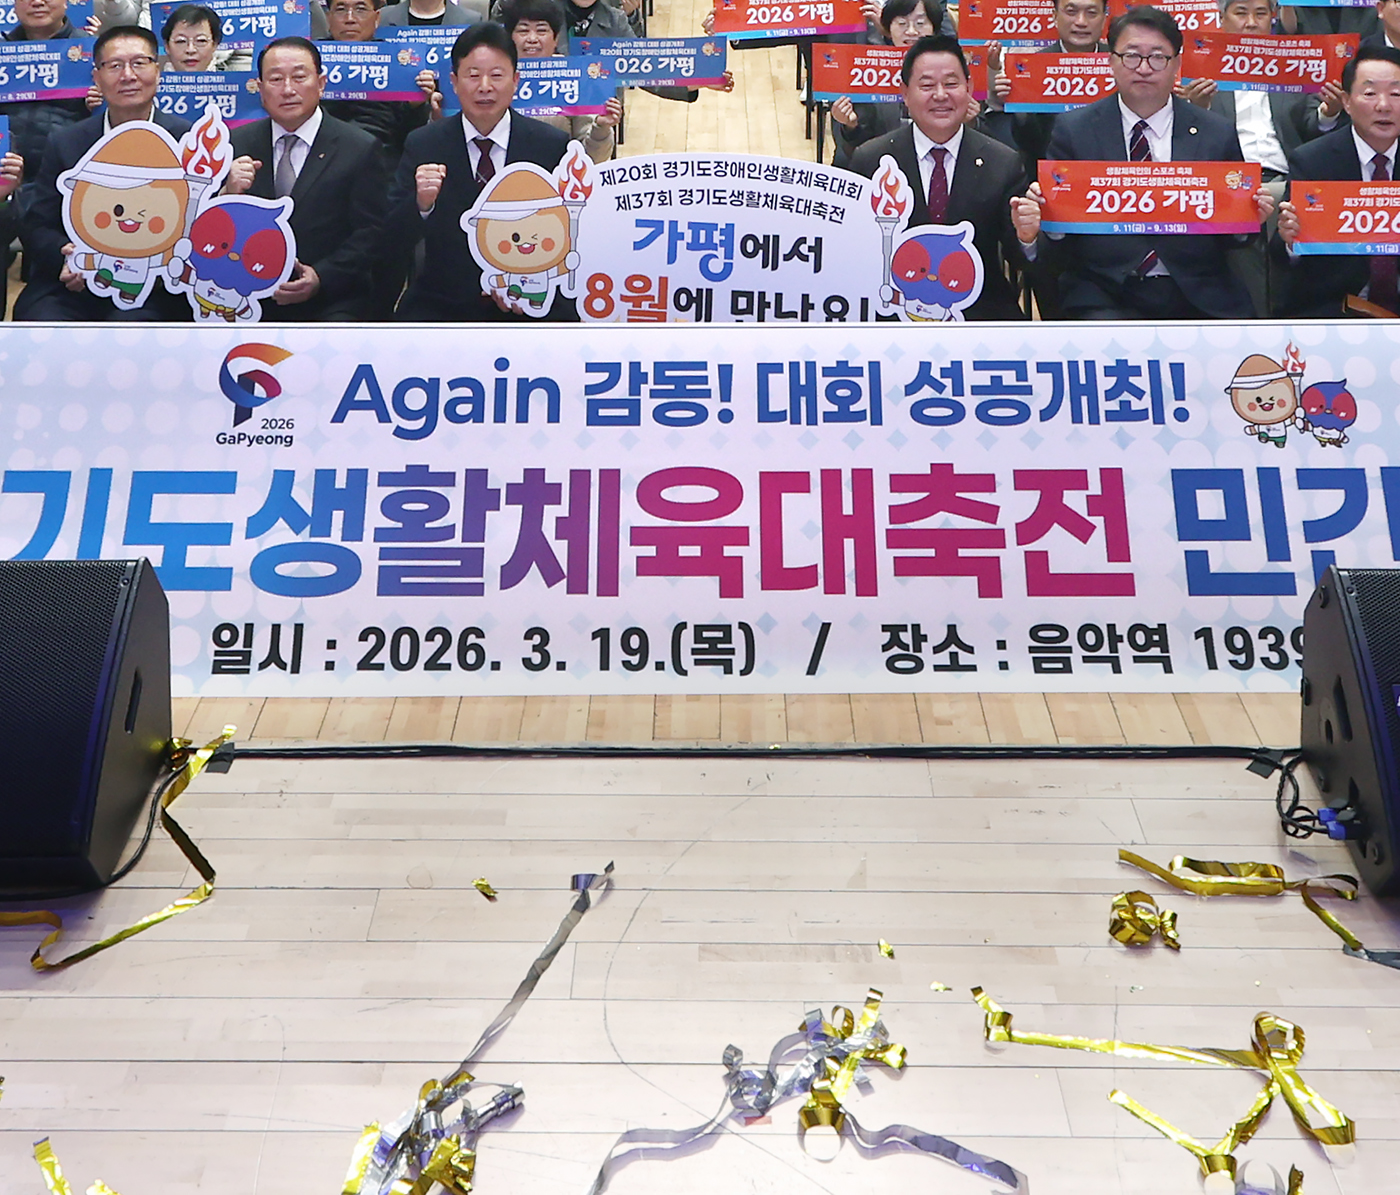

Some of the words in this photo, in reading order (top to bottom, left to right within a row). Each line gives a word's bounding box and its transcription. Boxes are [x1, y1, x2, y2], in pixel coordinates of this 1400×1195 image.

[746, 6, 795, 25] 2026
[799, 3, 834, 24] 가평
[240, 17, 277, 38] 가평
[15, 63, 59, 88] 가평
[348, 64, 389, 88] 가평
[659, 58, 695, 77] 가평
[1220, 55, 1279, 76] 2026
[1285, 58, 1327, 83] 가평
[538, 80, 579, 104] 가평
[1042, 76, 1099, 96] 2026
[599, 165, 658, 188] 제20회
[662, 160, 863, 202] 경기도장애인생활체육대회
[1090, 177, 1121, 187] 제37회
[1122, 177, 1208, 187] 경기도생활체육대축전
[1152, 167, 1175, 175] 스포츠
[614, 192, 674, 214] 제37회
[678, 189, 846, 226] 경기도생활체육대축전
[1085, 189, 1156, 214] 2026
[1162, 189, 1215, 220] 가평
[1343, 197, 1374, 207] 제37회
[632, 218, 824, 283] 가평에서
[583, 273, 713, 323] 8월에
[330, 356, 561, 441] Again
[584, 361, 735, 427] 감동!
[756, 360, 884, 427] 대회
[904, 360, 1191, 427] 성공개최!
[261, 418, 295, 431] 2026
[215, 432, 295, 447] GaPyeong
[211, 622, 306, 675] 일시
[357, 627, 500, 673] 2026.
[523, 627, 567, 673] 3.
[589, 622, 758, 677] 19.(목)
[880, 623, 977, 675] 장소
[1027, 621, 1174, 676] 음악역
